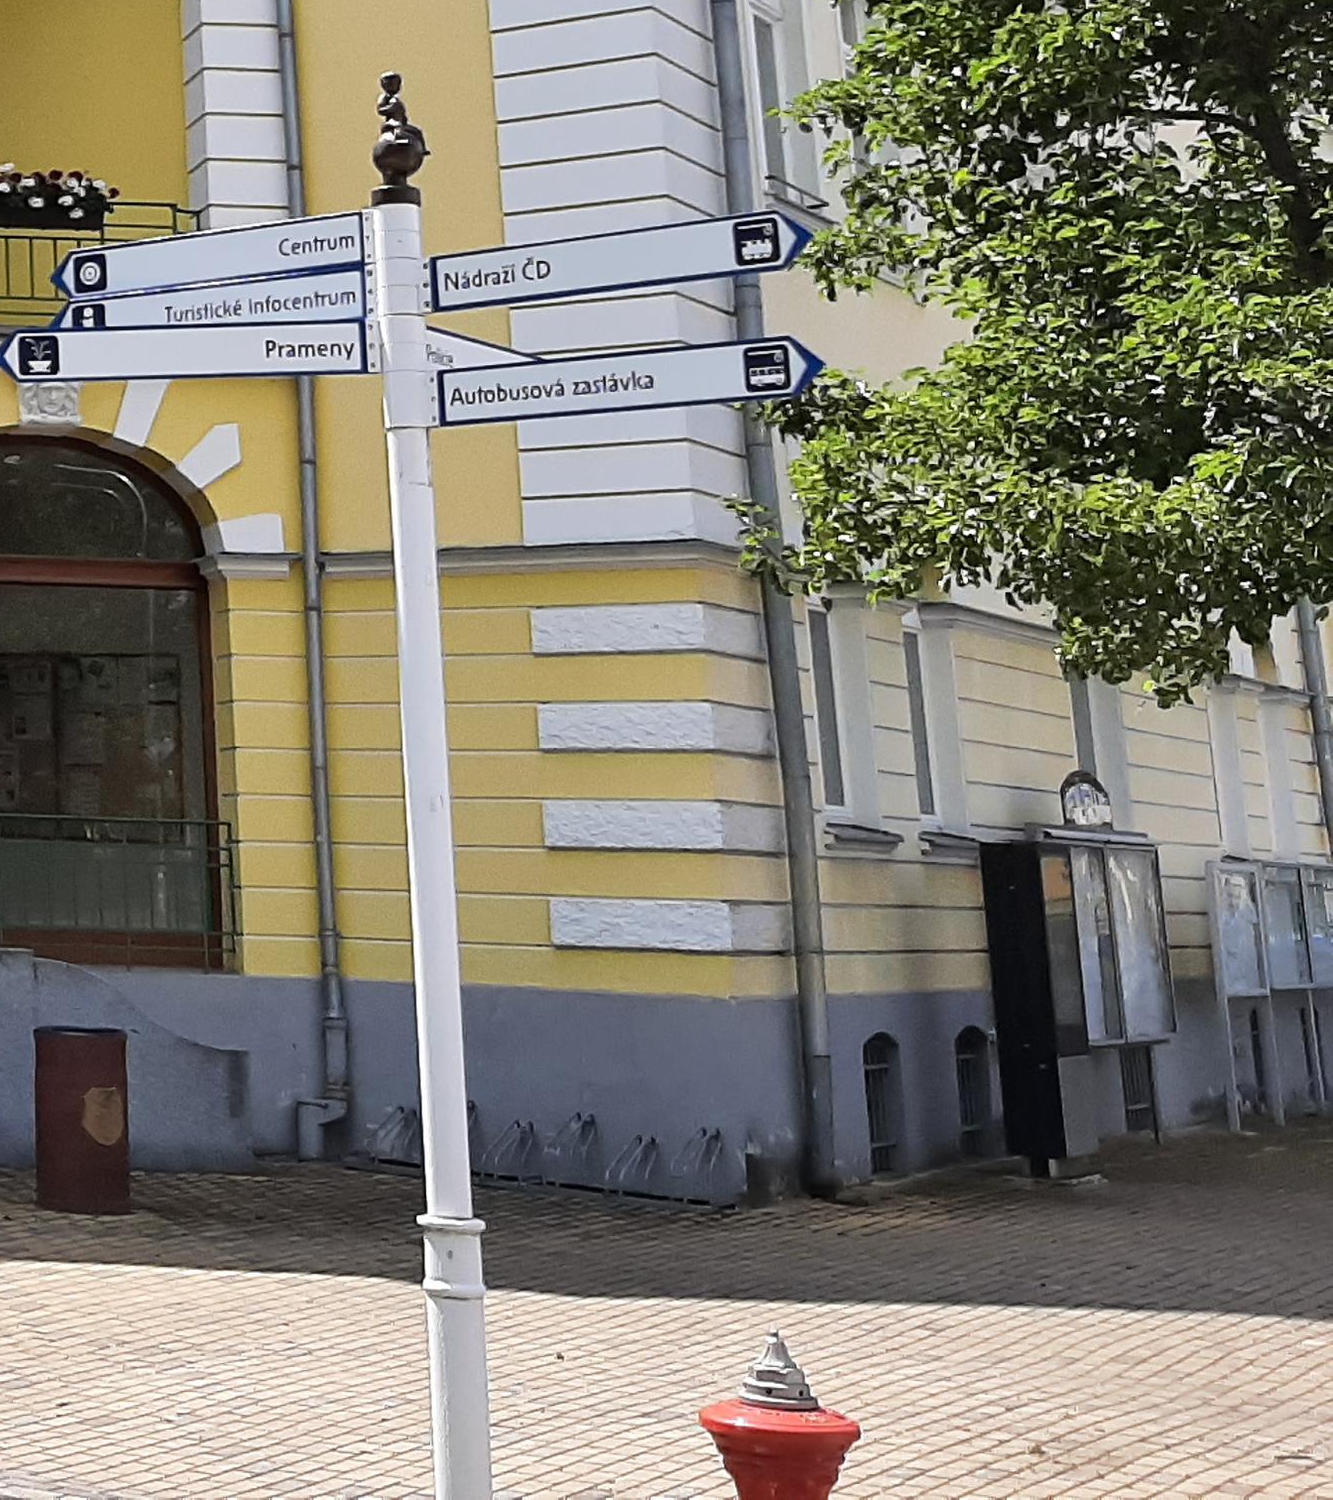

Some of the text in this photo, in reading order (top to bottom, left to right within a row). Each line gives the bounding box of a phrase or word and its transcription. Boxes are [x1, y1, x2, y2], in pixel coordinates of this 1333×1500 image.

[278, 235, 355, 257] Centrum
[443, 256, 552, 292] Nádraží ČD
[164, 299, 243, 323] Turistické
[264, 340, 355, 360] Prameny
[448, 371, 654, 407] Autobusová zastávka
